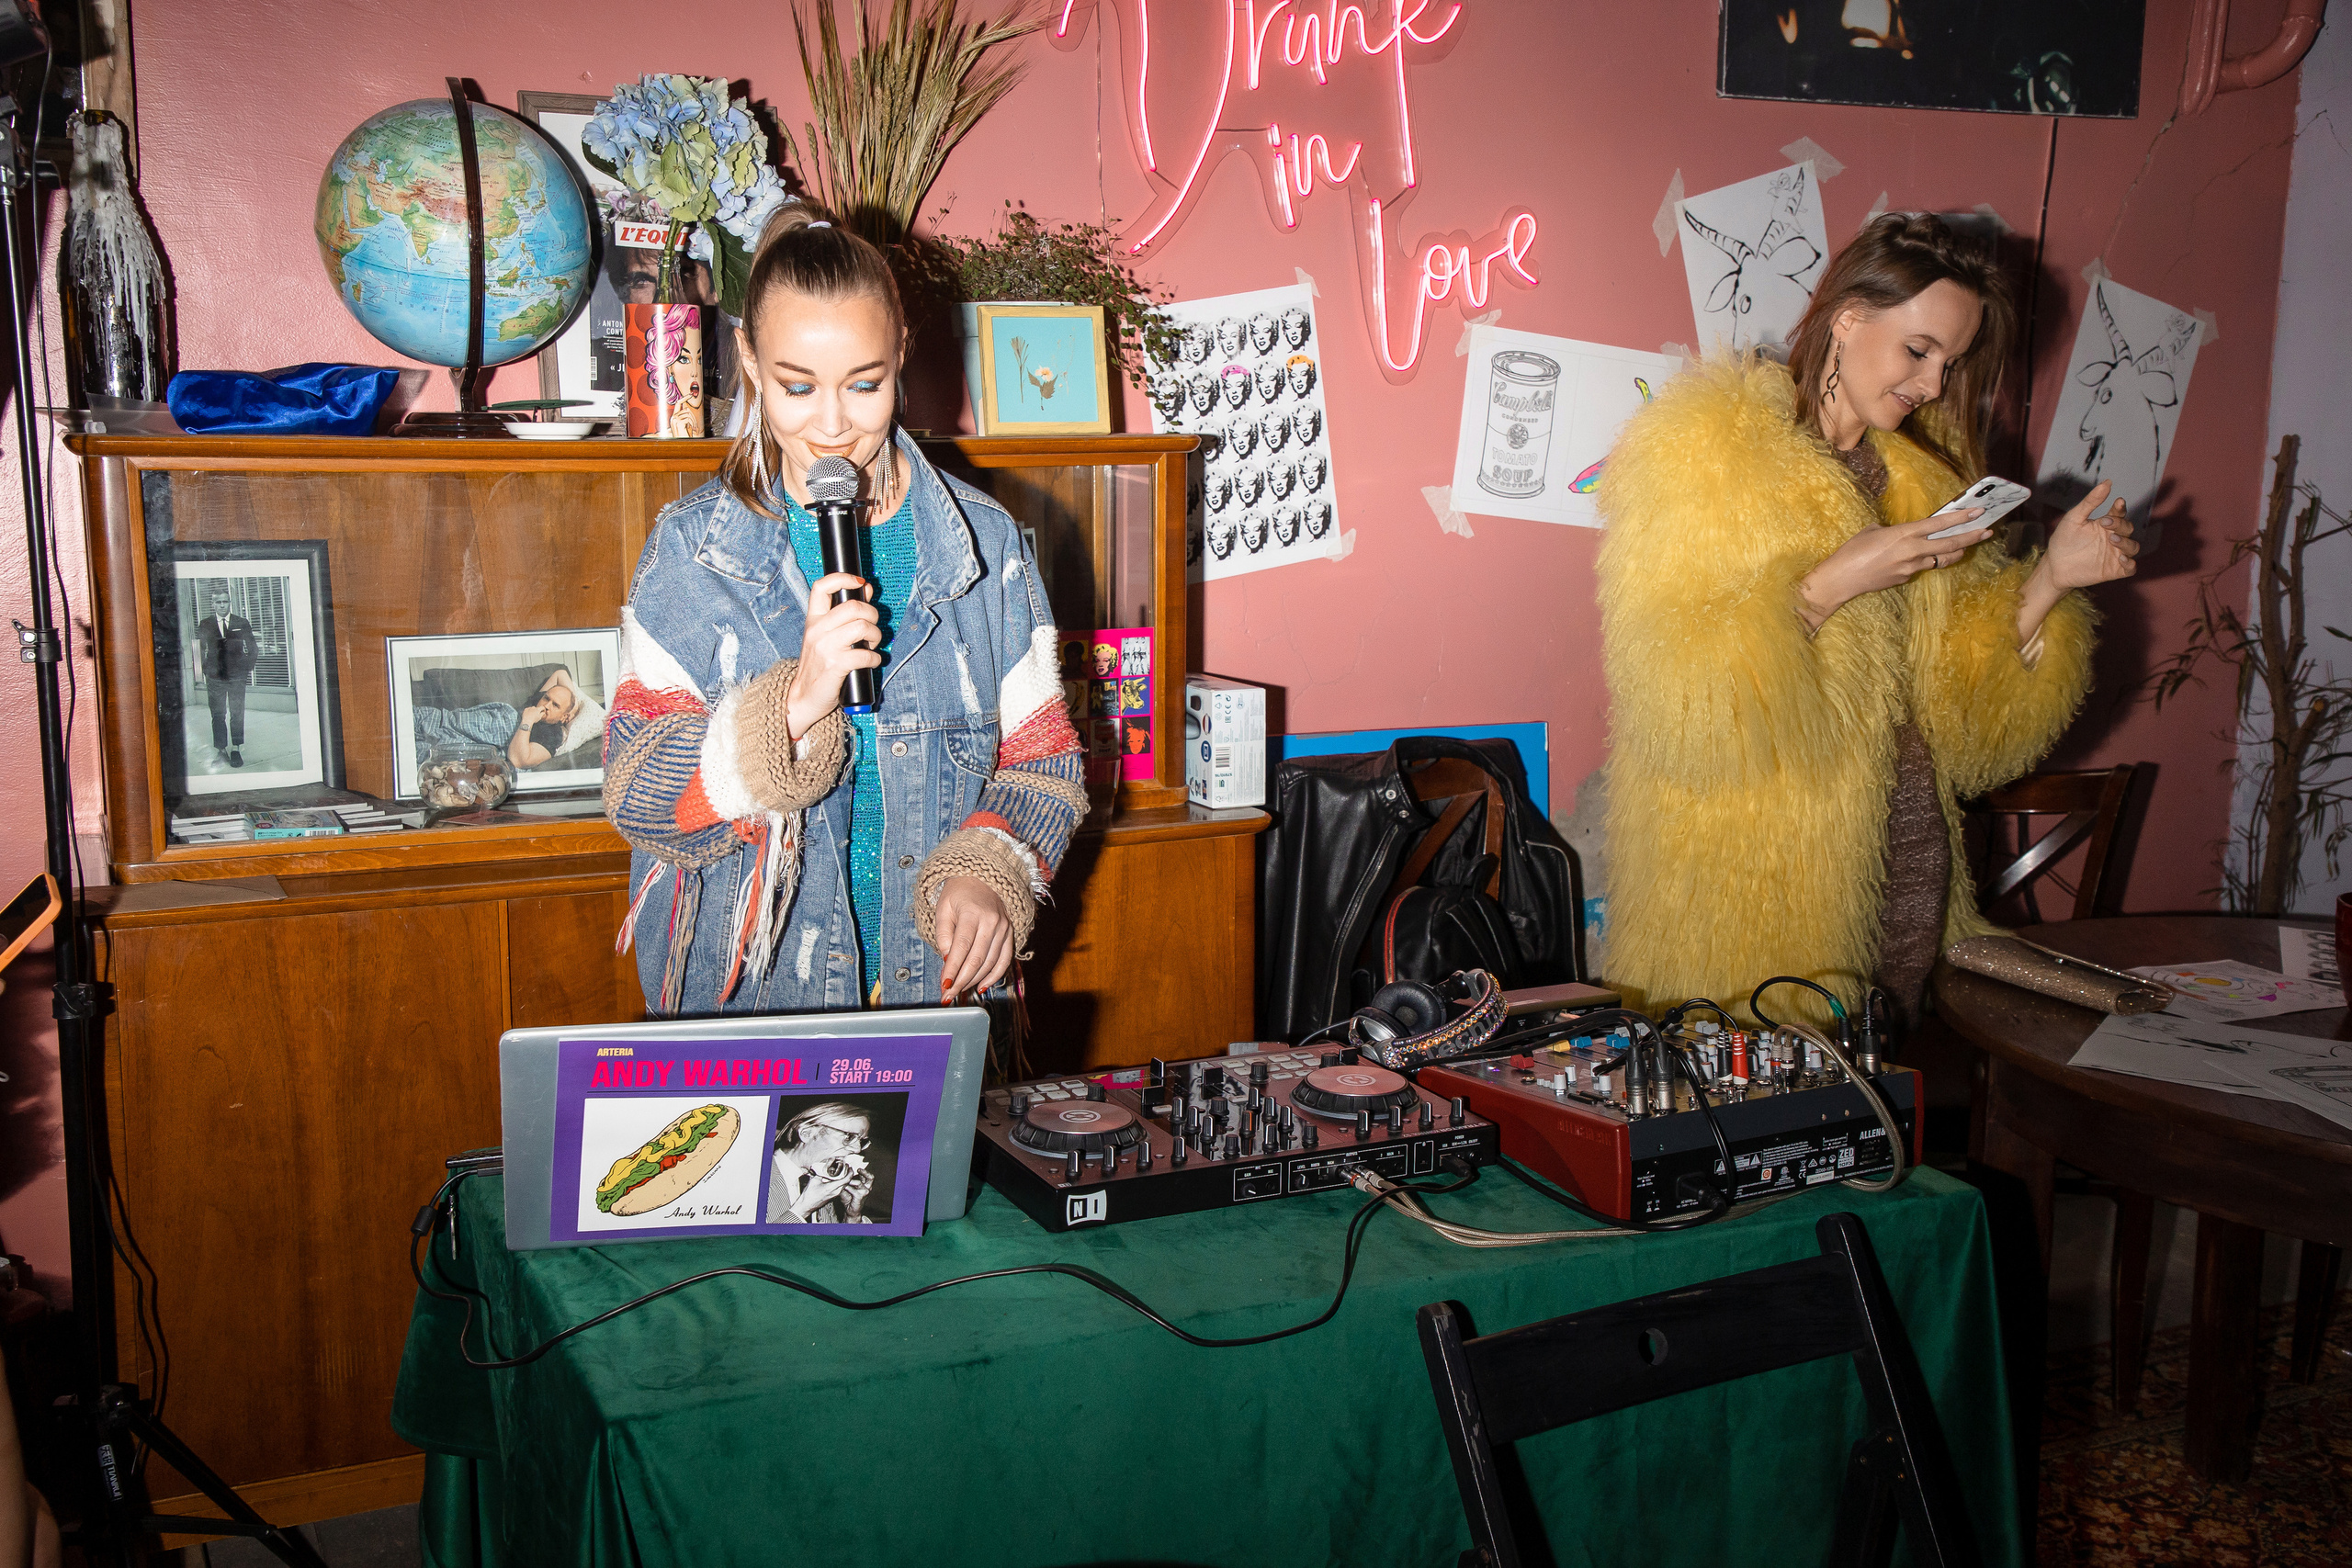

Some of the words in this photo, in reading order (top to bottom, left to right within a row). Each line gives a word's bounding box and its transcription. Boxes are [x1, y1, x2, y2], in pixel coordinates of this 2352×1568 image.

[1269, 122, 1363, 228] in
[620, 227, 689, 246] L'ÉQUI
[1372, 197, 1540, 372] Love
[602, 320, 624, 328] ANTON
[606, 327, 624, 335] CONT
[1492, 446, 1538, 466] TOMATO
[1492, 465, 1533, 483] SOUP
[596, 1047, 634, 1057] ARTERIA
[831, 1058, 874, 1072] 29.06.
[591, 1060, 676, 1089] ANDY
[684, 1058, 808, 1088] WARHOL
[829, 1071, 872, 1085] START
[876, 1069, 913, 1083] 19:00
[1838, 1146, 1855, 1159] ZED
[664, 1204, 696, 1219] Andy
[702, 1204, 742, 1217] Warhol
